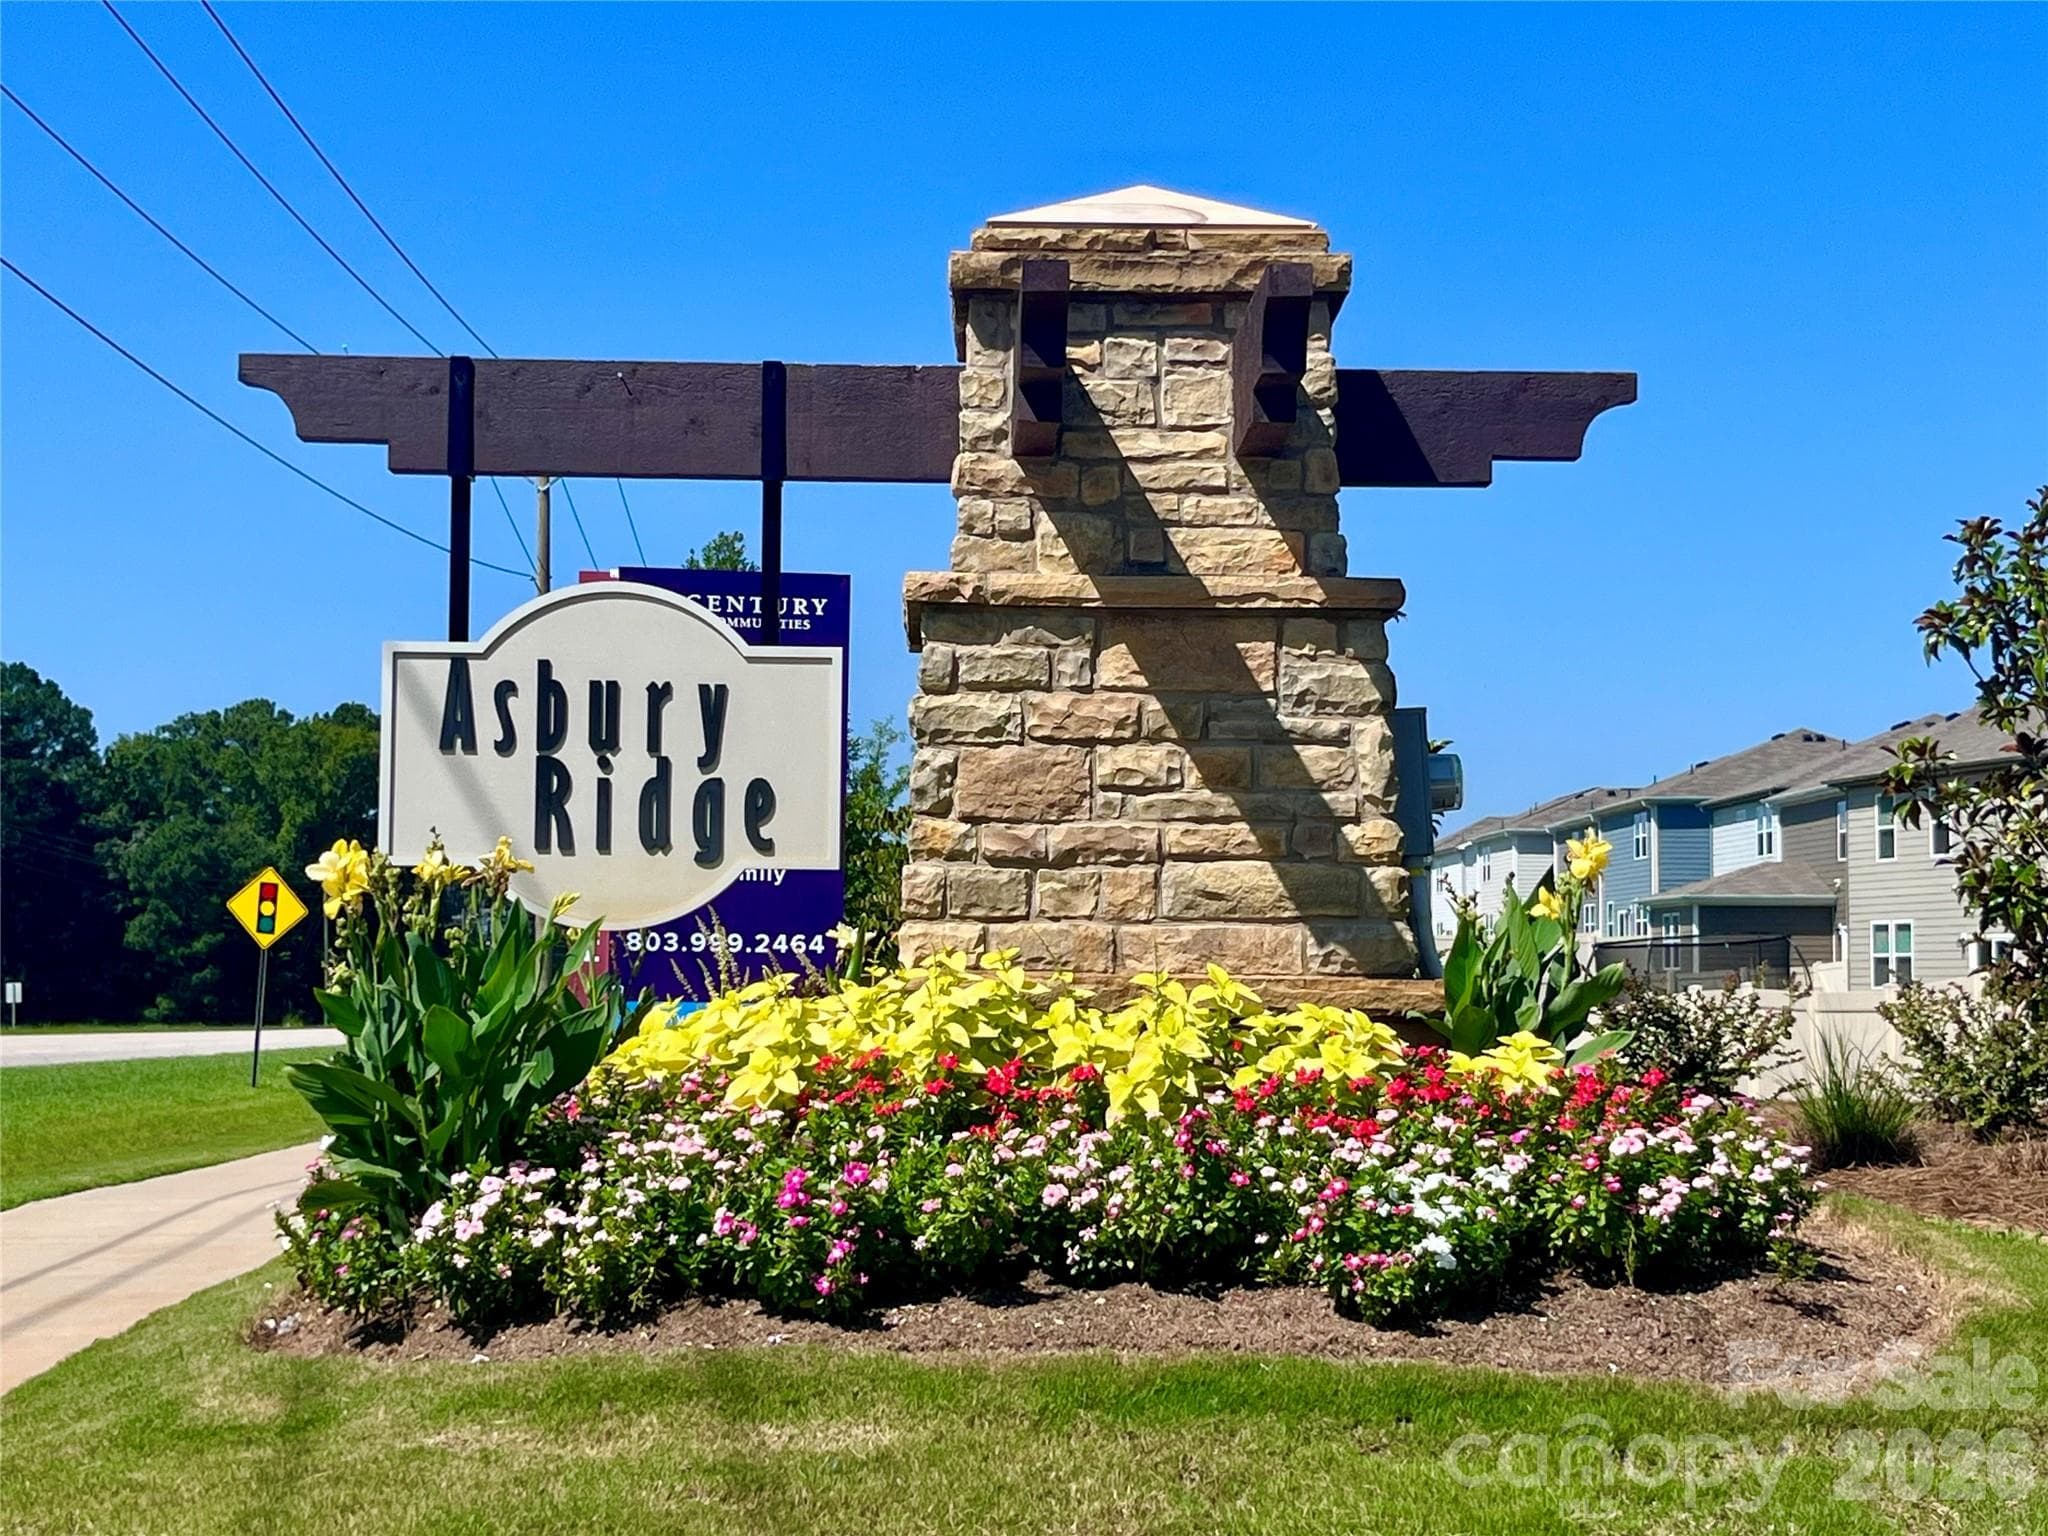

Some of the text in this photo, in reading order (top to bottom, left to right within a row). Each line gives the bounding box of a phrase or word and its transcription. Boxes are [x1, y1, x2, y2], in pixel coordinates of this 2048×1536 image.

[439, 657, 728, 775] Asbury
[534, 755, 777, 869] Ridge
[626, 931, 826, 955] 803.999.2464
